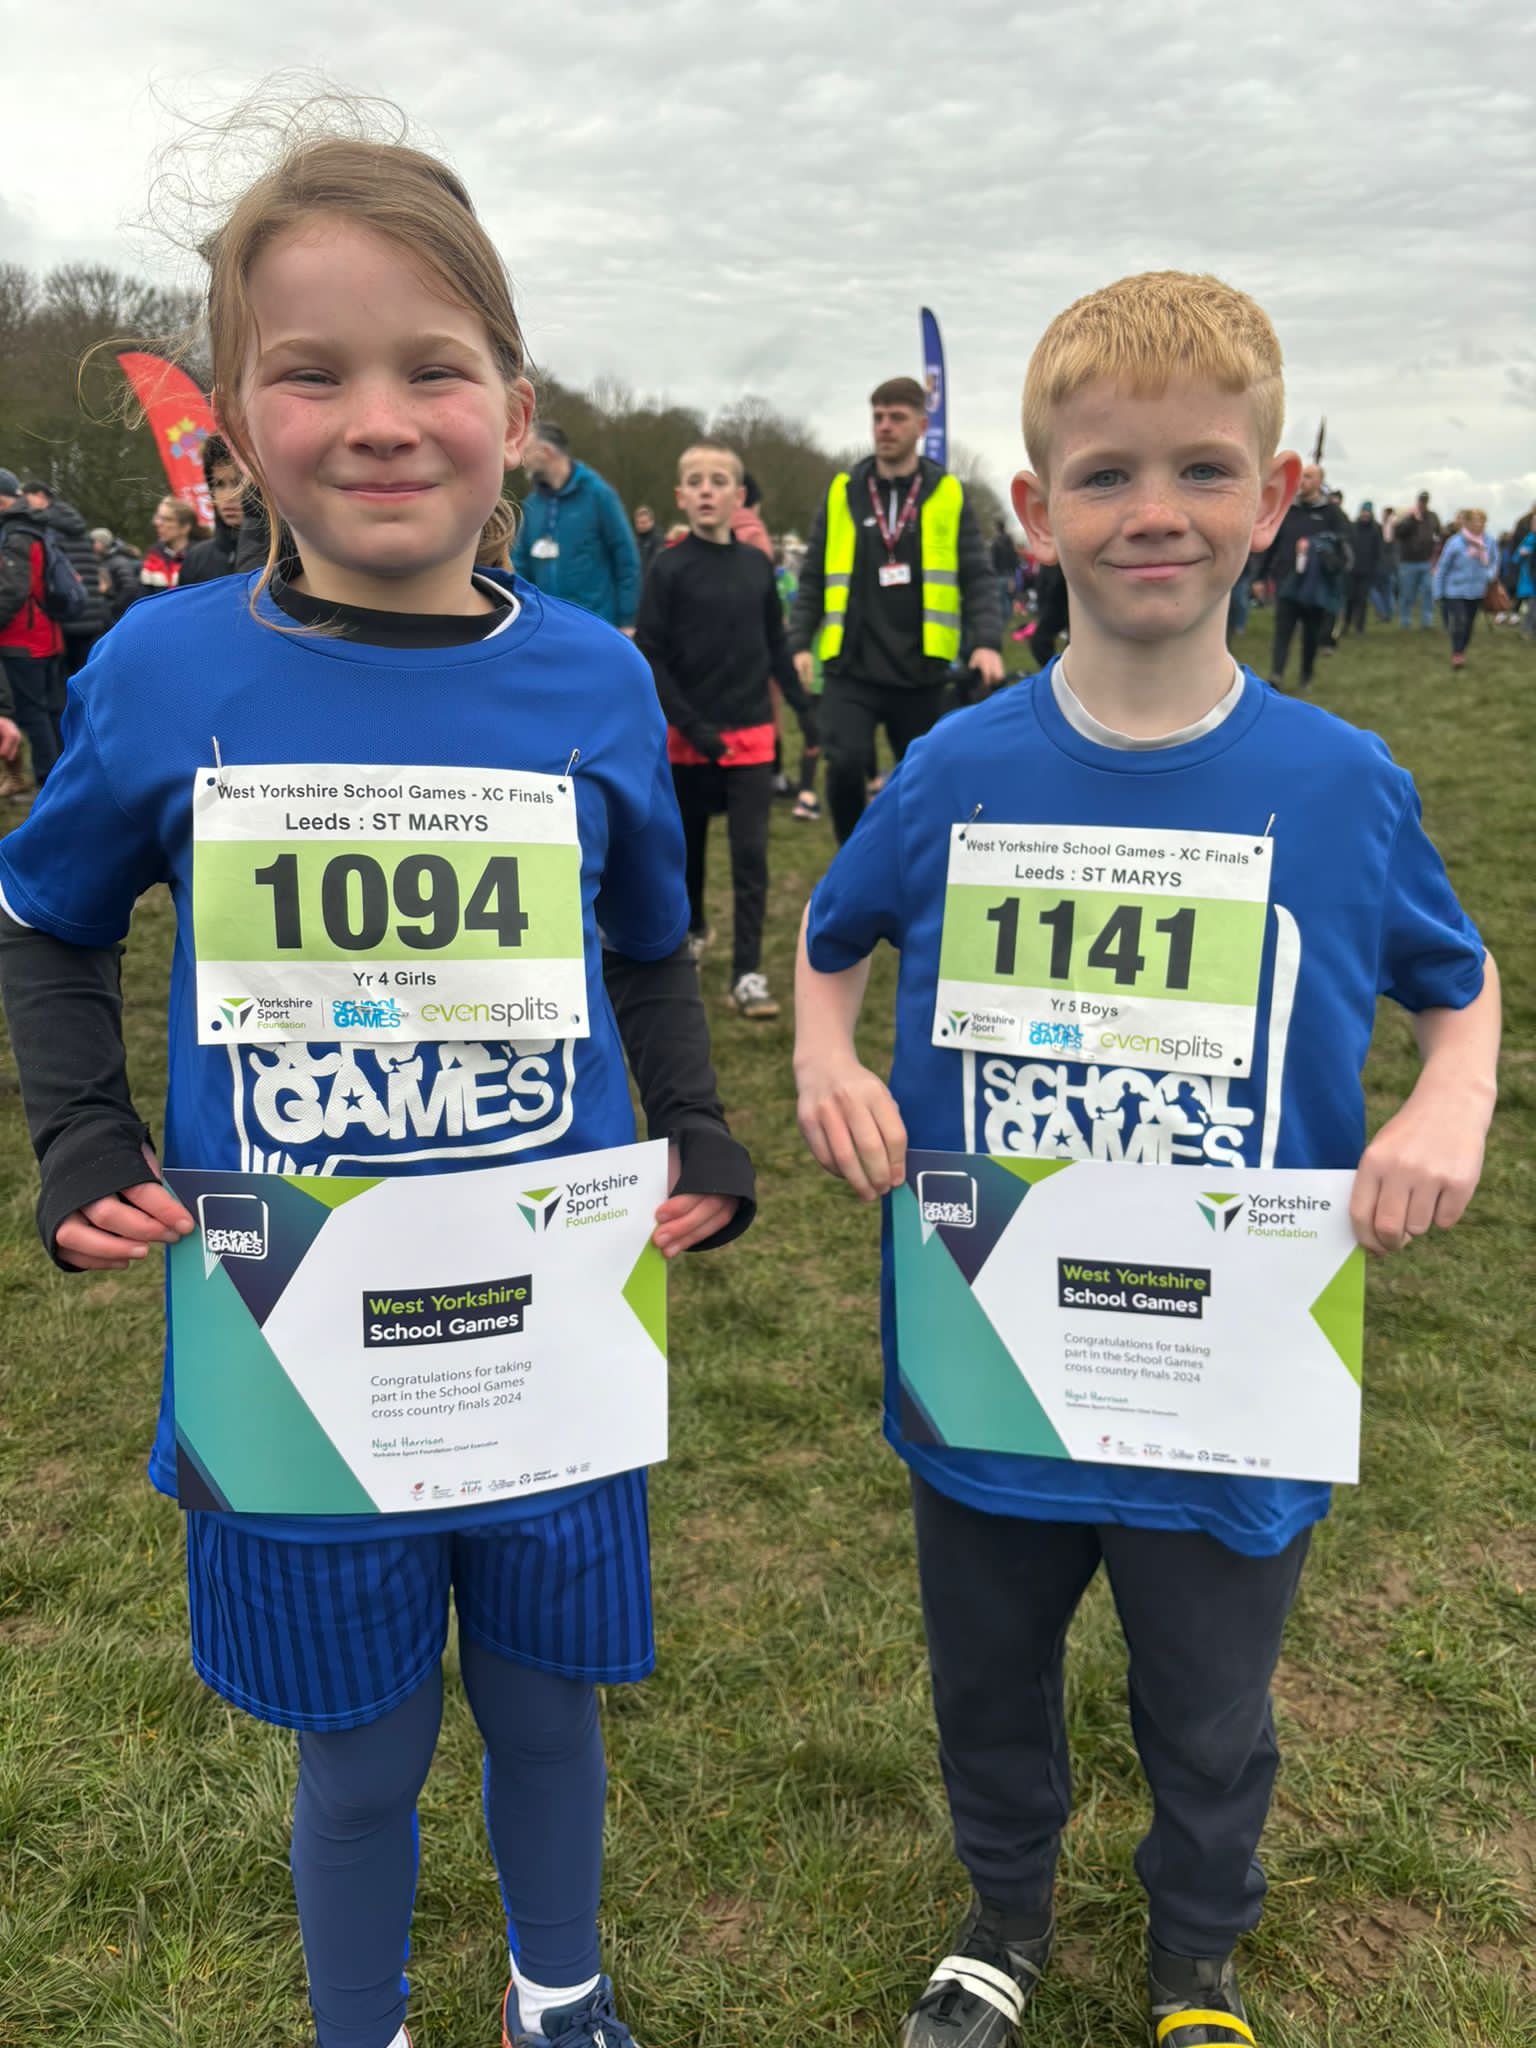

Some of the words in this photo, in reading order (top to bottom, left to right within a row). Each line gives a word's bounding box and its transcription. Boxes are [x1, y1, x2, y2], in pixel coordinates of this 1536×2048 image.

[218, 784, 255, 800] West
[260, 784, 338, 798] Yorkshire
[343, 784, 403, 800] School
[408, 785, 466, 800] Games
[481, 787, 504, 802] XC
[508, 788, 554, 804] Finals
[285, 813, 351, 831] Leeds
[372, 813, 401, 831] ST
[408, 814, 488, 832] MARYS
[966, 840, 995, 852] West
[998, 840, 1060, 855] Yorkshire
[1063, 842, 1111, 856] School
[1115, 844, 1165, 860] Games
[1179, 847, 1201, 862] XC
[1205, 850, 1250, 865] Finals
[1014, 864, 1064, 881] Leeds
[1082, 866, 1107, 882] ST
[1111, 868, 1183, 888] MARYS
[254, 853, 529, 951] 1094
[987, 897, 1196, 990] 1141
[353, 972, 374, 987] Yr
[378, 972, 390, 986] 4
[395, 971, 436, 986] Girls
[256, 998, 312, 1009] Yorkshire
[257, 1008, 290, 1020] Sport
[420, 998, 559, 1028] evensplits
[1051, 998, 1066, 1012] Yr
[1068, 1000, 1076, 1012] 5
[1080, 1002, 1118, 1018] Boys
[257, 1020, 306, 1029] Foundation
[334, 1007, 400, 1028] GAMES
[972, 1012, 1016, 1026] Yorkshire
[972, 1022, 995, 1034] Sport
[1100, 1030, 1223, 1060] evensplits
[253, 1046, 554, 1144] GAMES
[566, 1174, 638, 1198] Yorkshire
[566, 1196, 608, 1216] Sport
[1248, 1194, 1331, 1212] Yorkshire
[566, 1207, 628, 1228] Foundation
[1248, 1210, 1296, 1226] Sport
[1248, 1226, 1318, 1240] Foundation
[1063, 1264, 1110, 1284] West
[1116, 1268, 1206, 1292] Yorkshire
[369, 1297, 424, 1315] West
[430, 1286, 528, 1312] Yorkshire
[1063, 1287, 1127, 1309] School
[1132, 1293, 1198, 1314] Games
[370, 1320, 443, 1341] School
[449, 1313, 520, 1335] Games
[1064, 1332, 1154, 1351] Congratulations
[1156, 1341, 1172, 1352] for
[1175, 1343, 1210, 1357] taking
[1064, 1348, 1088, 1360] part
[1090, 1350, 1100, 1360] in
[1103, 1350, 1122, 1362] the
[1124, 1352, 1162, 1365] School
[1164, 1356, 1204, 1369] Games
[370, 1369, 472, 1388] Congratulations
[474, 1366, 492, 1378] for
[495, 1360, 532, 1373] taking
[1064, 1363, 1092, 1374] cross
[1095, 1364, 1138, 1378] country
[1140, 1368, 1170, 1380] finals
[1173, 1372, 1201, 1383] 2024
[371, 1392, 397, 1404] part
[400, 1390, 412, 1401] in
[416, 1388, 437, 1400] the
[439, 1383, 481, 1398] School
[484, 1376, 525, 1392] Games
[372, 1408, 404, 1418] cross
[406, 1403, 454, 1417] country
[457, 1398, 490, 1412] finals
[493, 1392, 522, 1407] 2024
